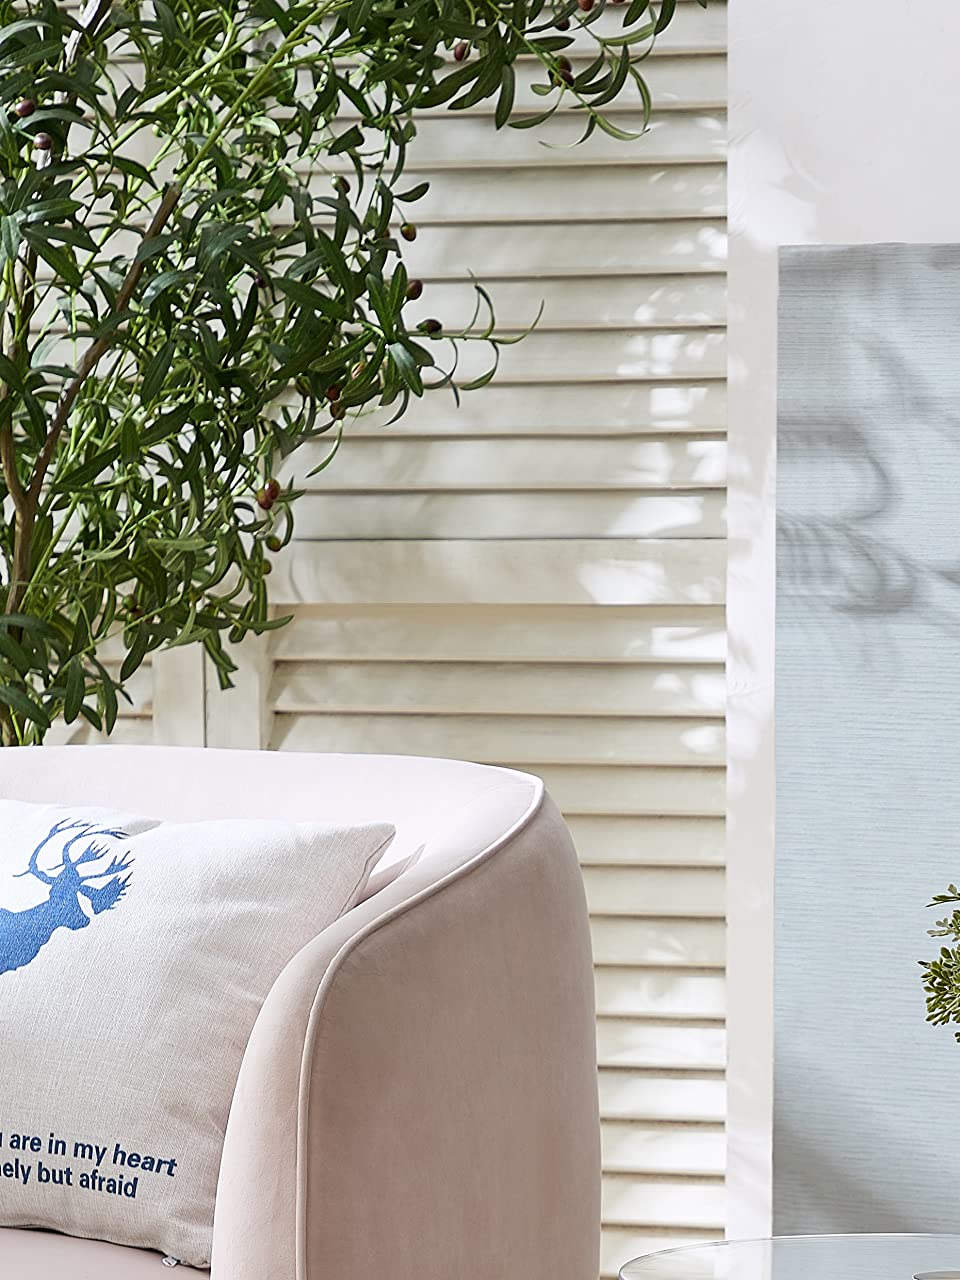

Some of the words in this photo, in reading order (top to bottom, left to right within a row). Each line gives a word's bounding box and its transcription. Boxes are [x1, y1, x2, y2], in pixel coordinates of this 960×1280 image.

[9, 1133, 41, 1153] are
[48, 1132, 67, 1157] in
[73, 1141, 107, 1168] my
[112, 1143, 178, 1177] heart
[37, 1161, 73, 1187] but
[79, 1169, 139, 1198] afraid
